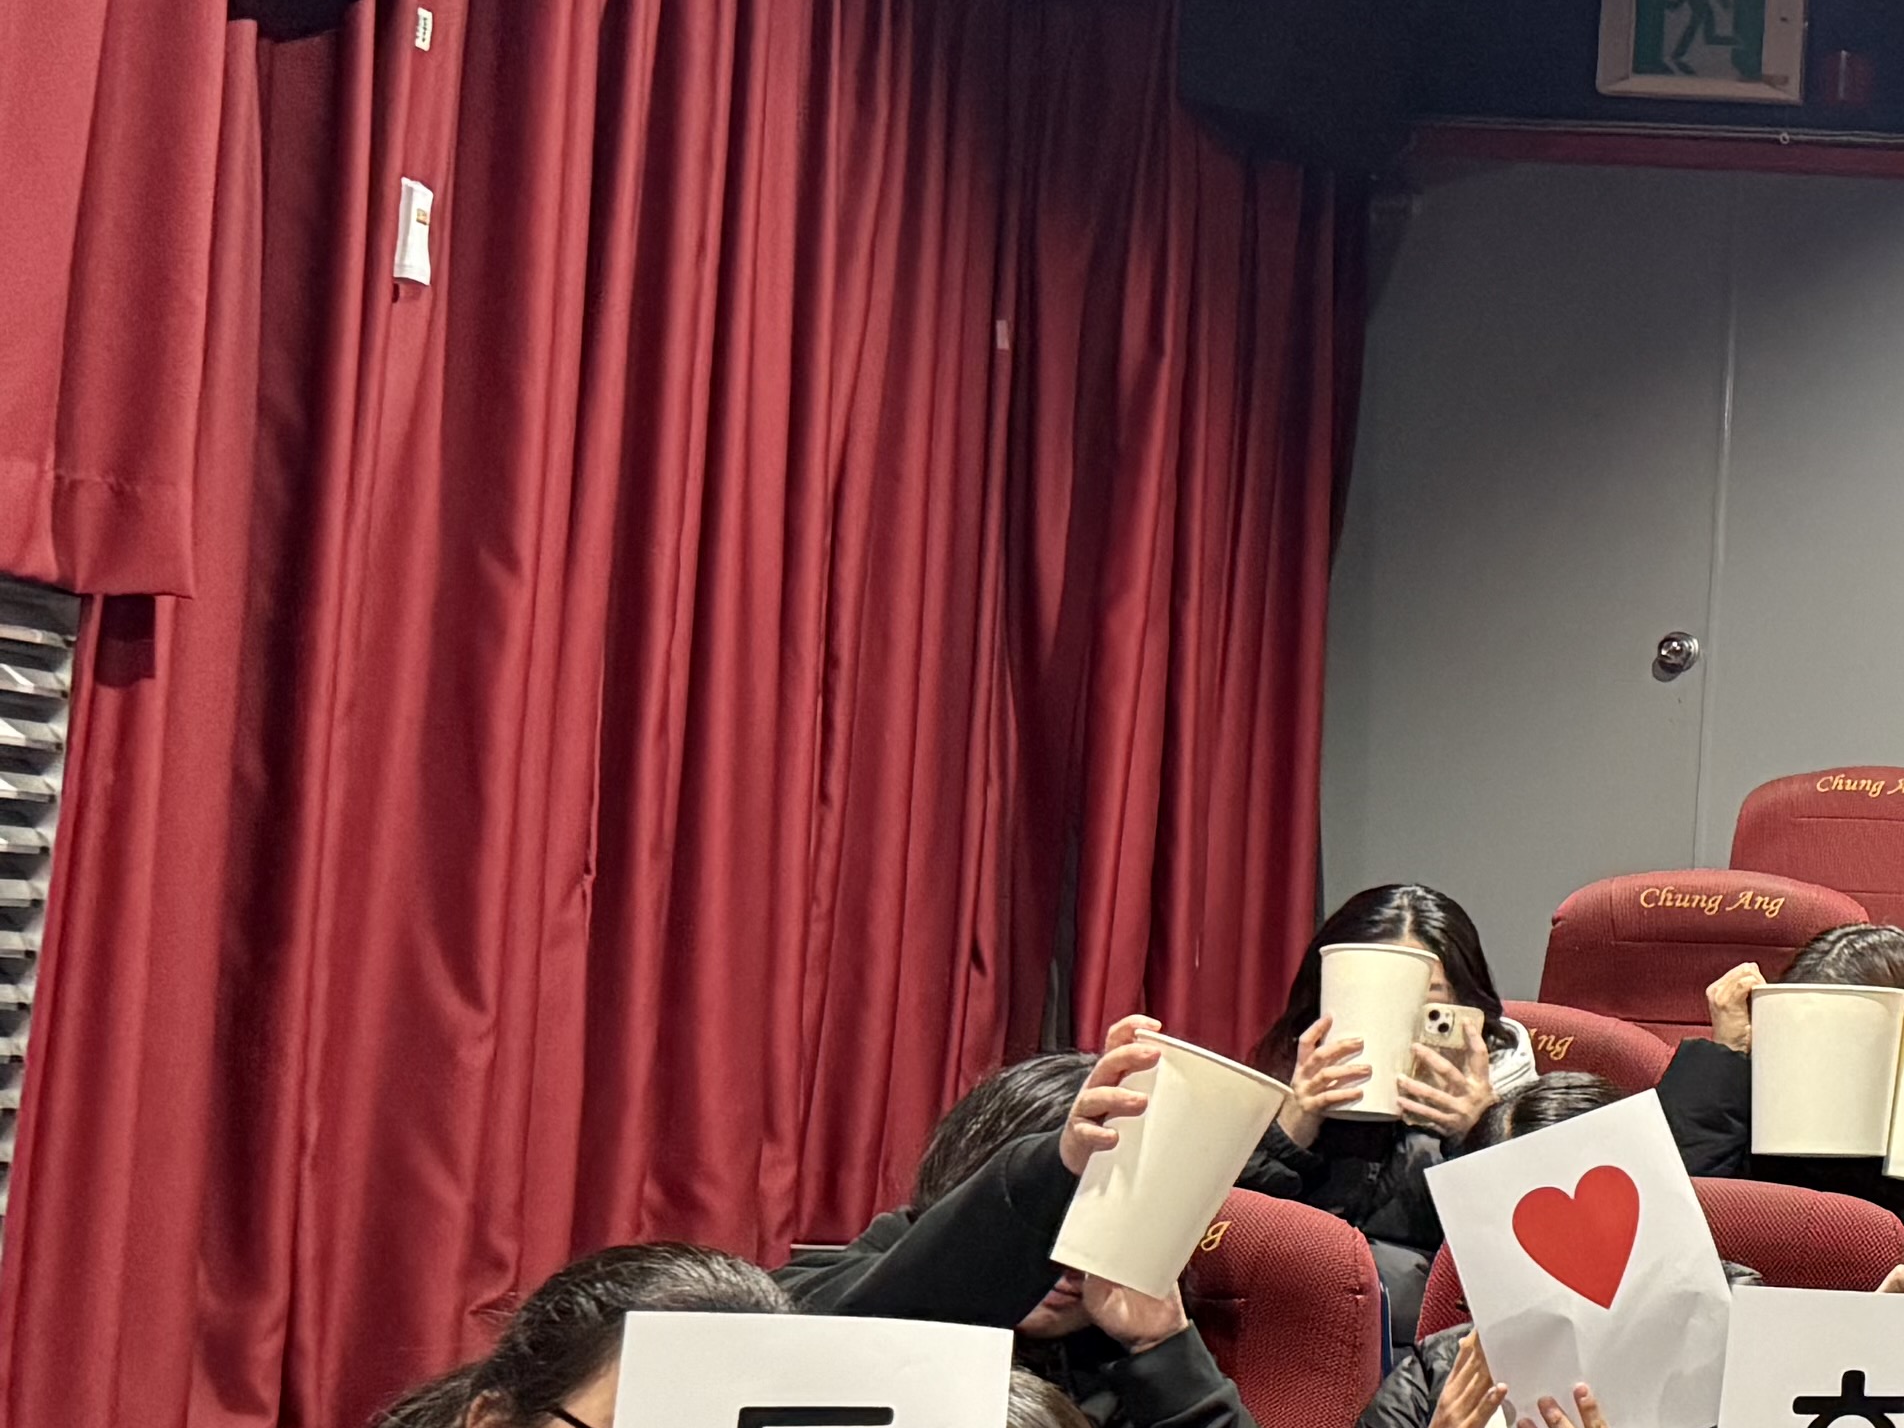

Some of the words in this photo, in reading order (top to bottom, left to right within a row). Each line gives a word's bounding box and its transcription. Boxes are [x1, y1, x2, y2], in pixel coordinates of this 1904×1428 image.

[1816, 774, 1886, 798] Chung
[1639, 886, 1723, 915] Chung
[1725, 890, 1786, 919] Ang
